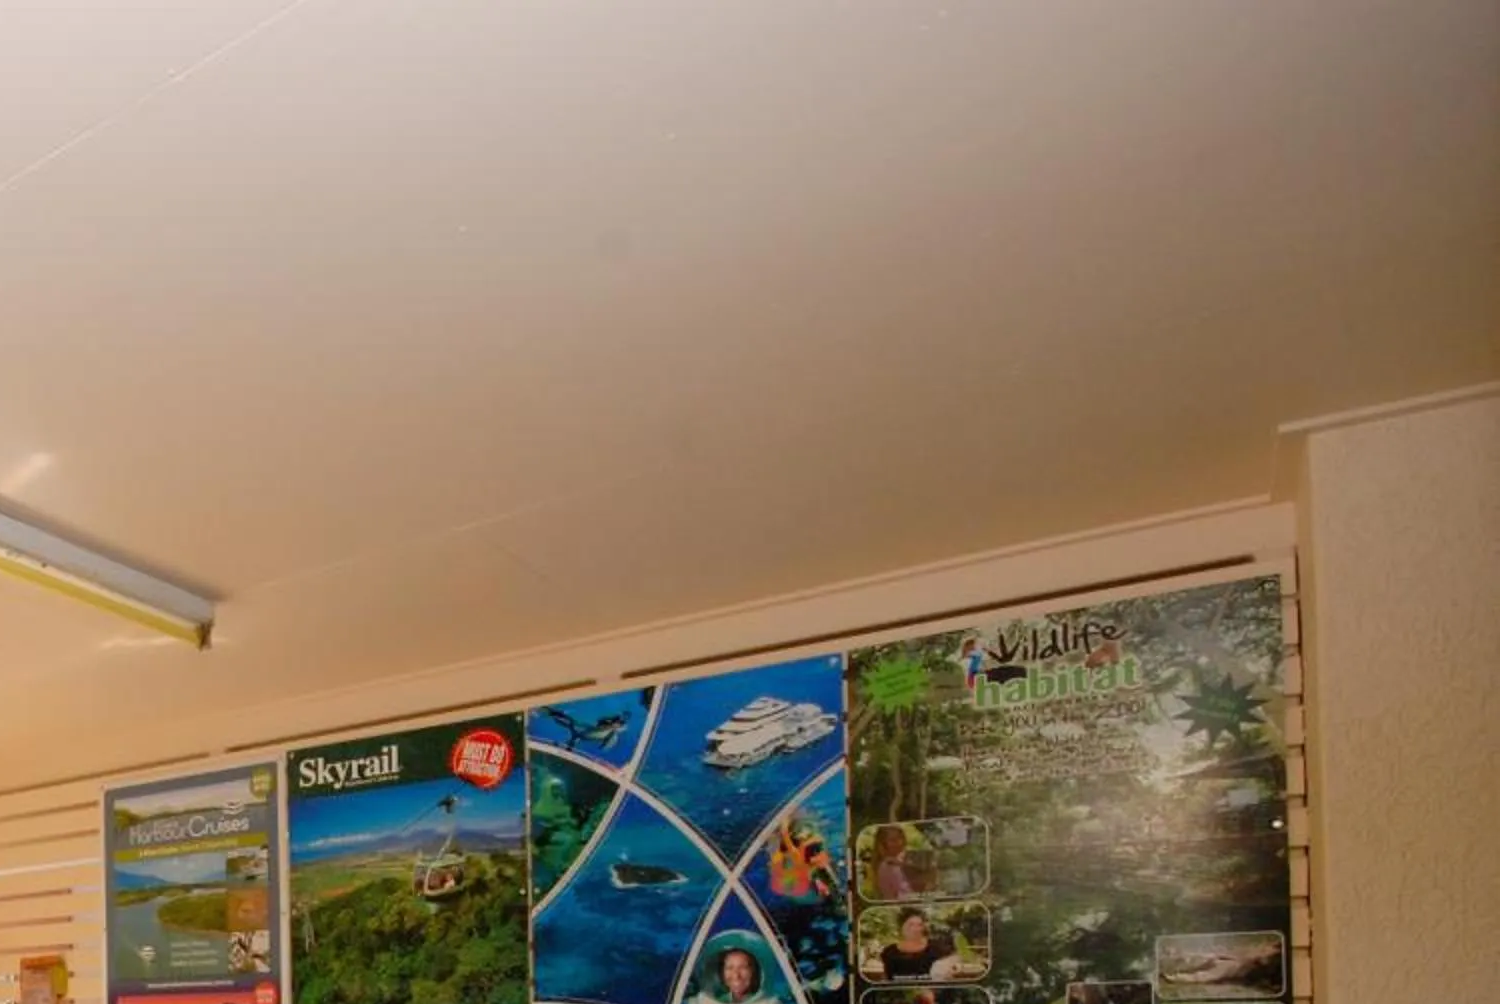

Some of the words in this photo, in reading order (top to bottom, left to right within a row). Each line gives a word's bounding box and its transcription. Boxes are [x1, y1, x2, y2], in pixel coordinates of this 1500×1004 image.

[985, 621, 1128, 664] Wildlife
[975, 654, 1139, 707] habitat
[299, 744, 401, 789] Skyrail
[129, 820, 184, 846] Harbour
[187, 815, 250, 837] Cruises
